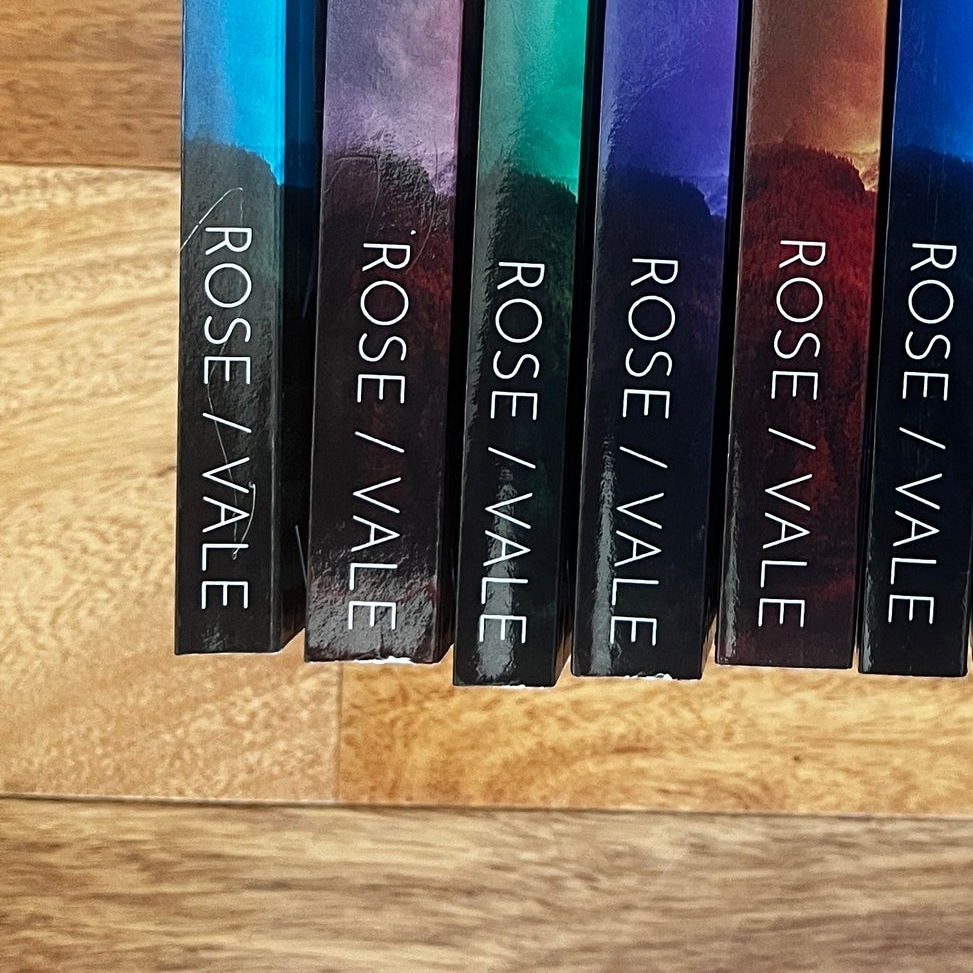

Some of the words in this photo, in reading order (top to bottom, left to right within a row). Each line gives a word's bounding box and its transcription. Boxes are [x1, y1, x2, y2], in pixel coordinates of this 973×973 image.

[203, 226, 253, 386] ROSE
[356, 242, 411, 405] ROSE
[490, 261, 545, 421] ROSE
[621, 257, 679, 419] ROSE
[771, 240, 827, 401] ROSE
[901, 242, 957, 402] ROSE
[200, 456, 256, 611] VALE
[348, 477, 401, 631] VALE
[479, 492, 533, 645] VALE
[609, 492, 664, 647] VALE
[758, 474, 812, 629] VALE
[887, 473, 943, 625] VALE
